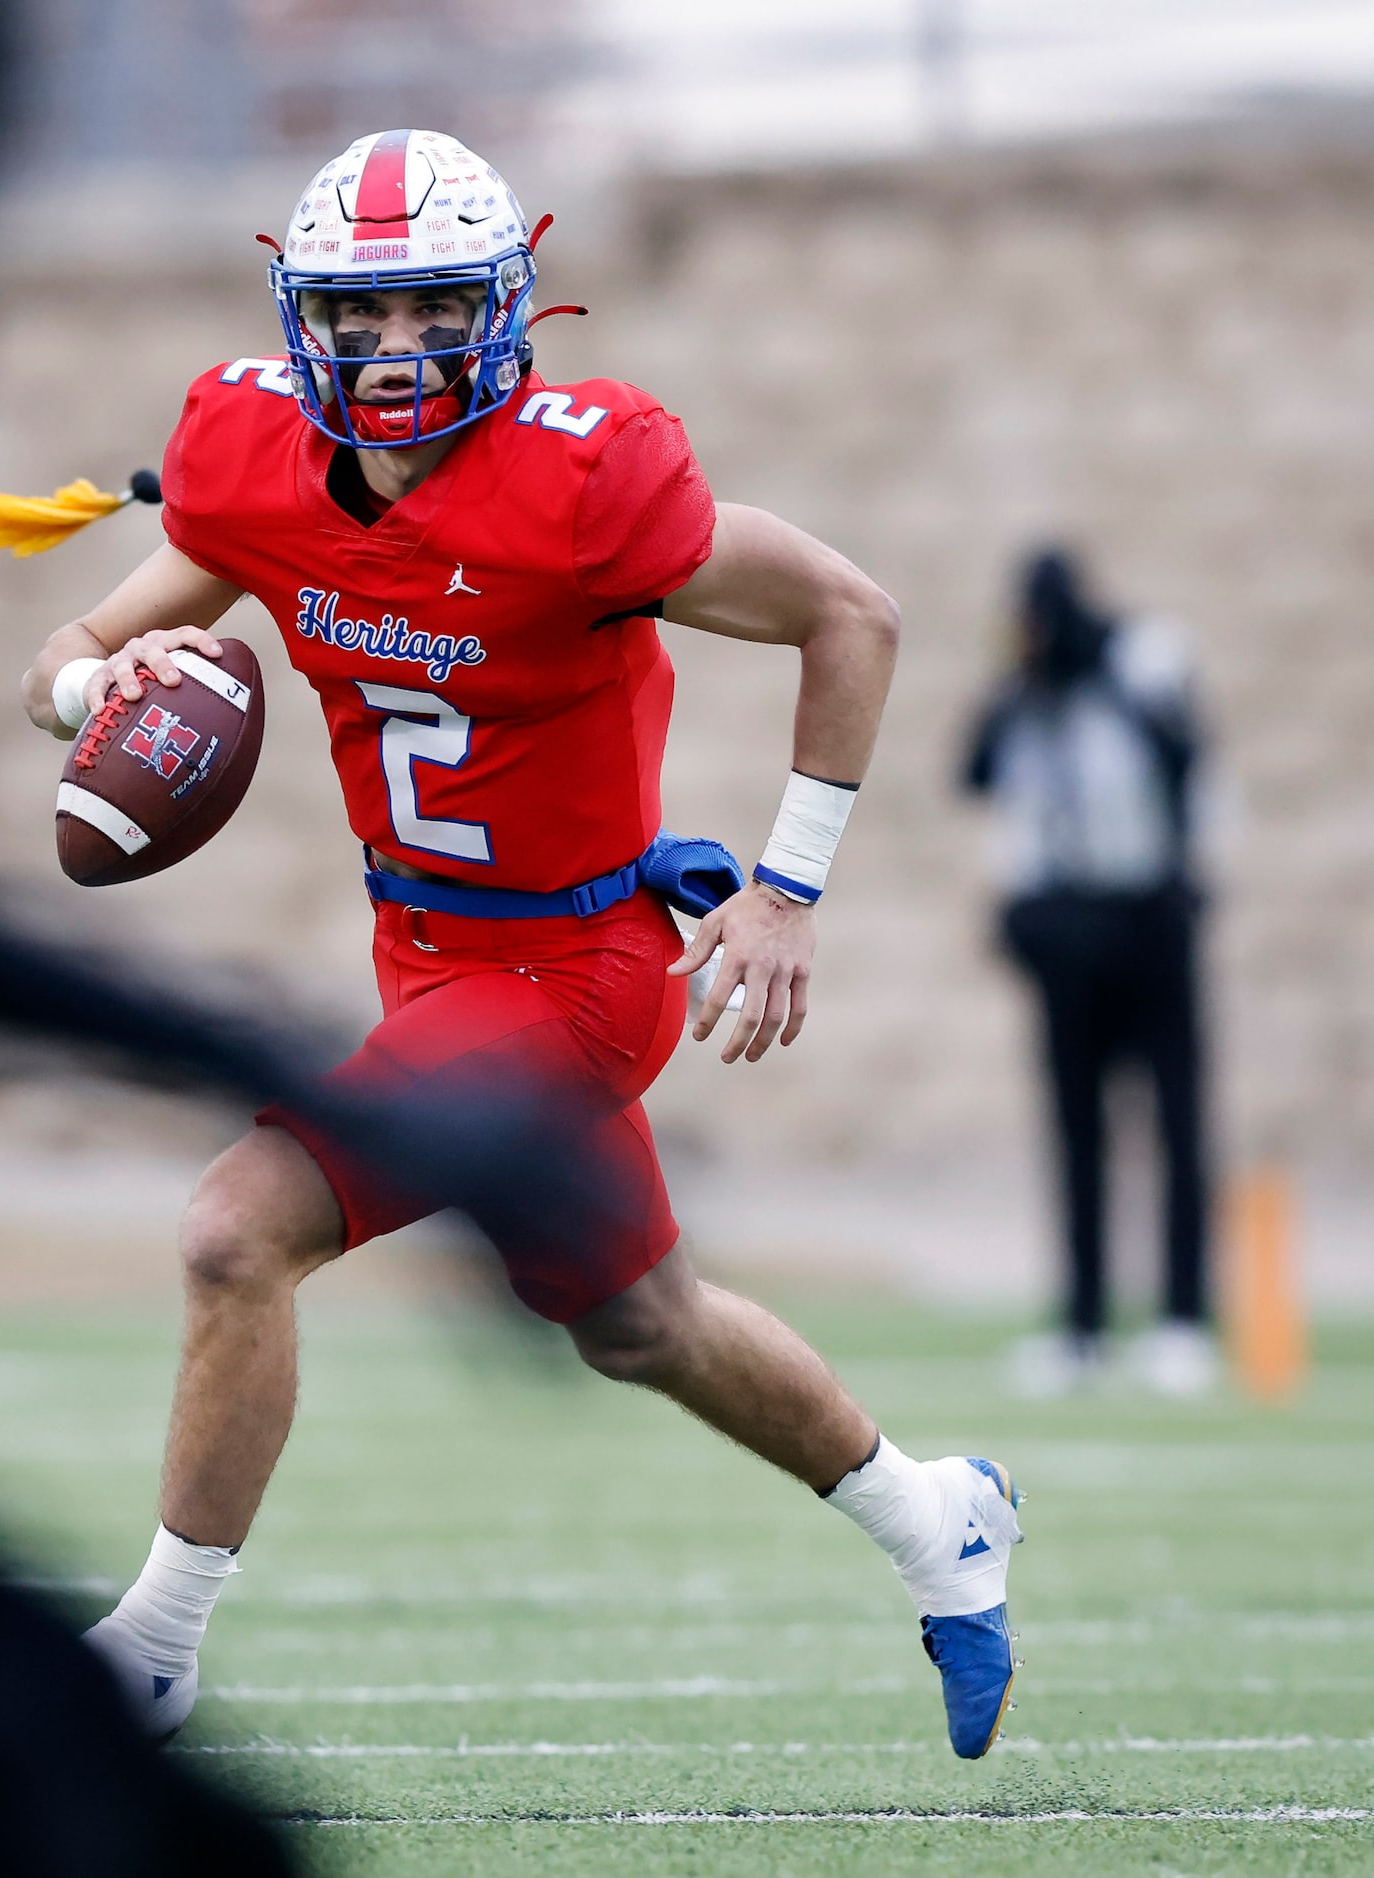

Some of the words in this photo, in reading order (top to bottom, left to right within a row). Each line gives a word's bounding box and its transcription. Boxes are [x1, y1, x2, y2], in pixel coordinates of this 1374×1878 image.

[426, 219, 451, 232] FIGHT
[318, 240, 340, 253] FIGHT
[352, 244, 409, 262] JAGUARS
[431, 241, 456, 254] FIGHT
[466, 240, 487, 252] FIGHT
[378, 408, 415, 421] Riddell
[514, 391, 609, 440] 2
[296, 586, 487, 683] Heritage
[169, 768, 199, 799] TEAM
[197, 735, 219, 771] ISSUE
[351, 676, 496, 865] 2
